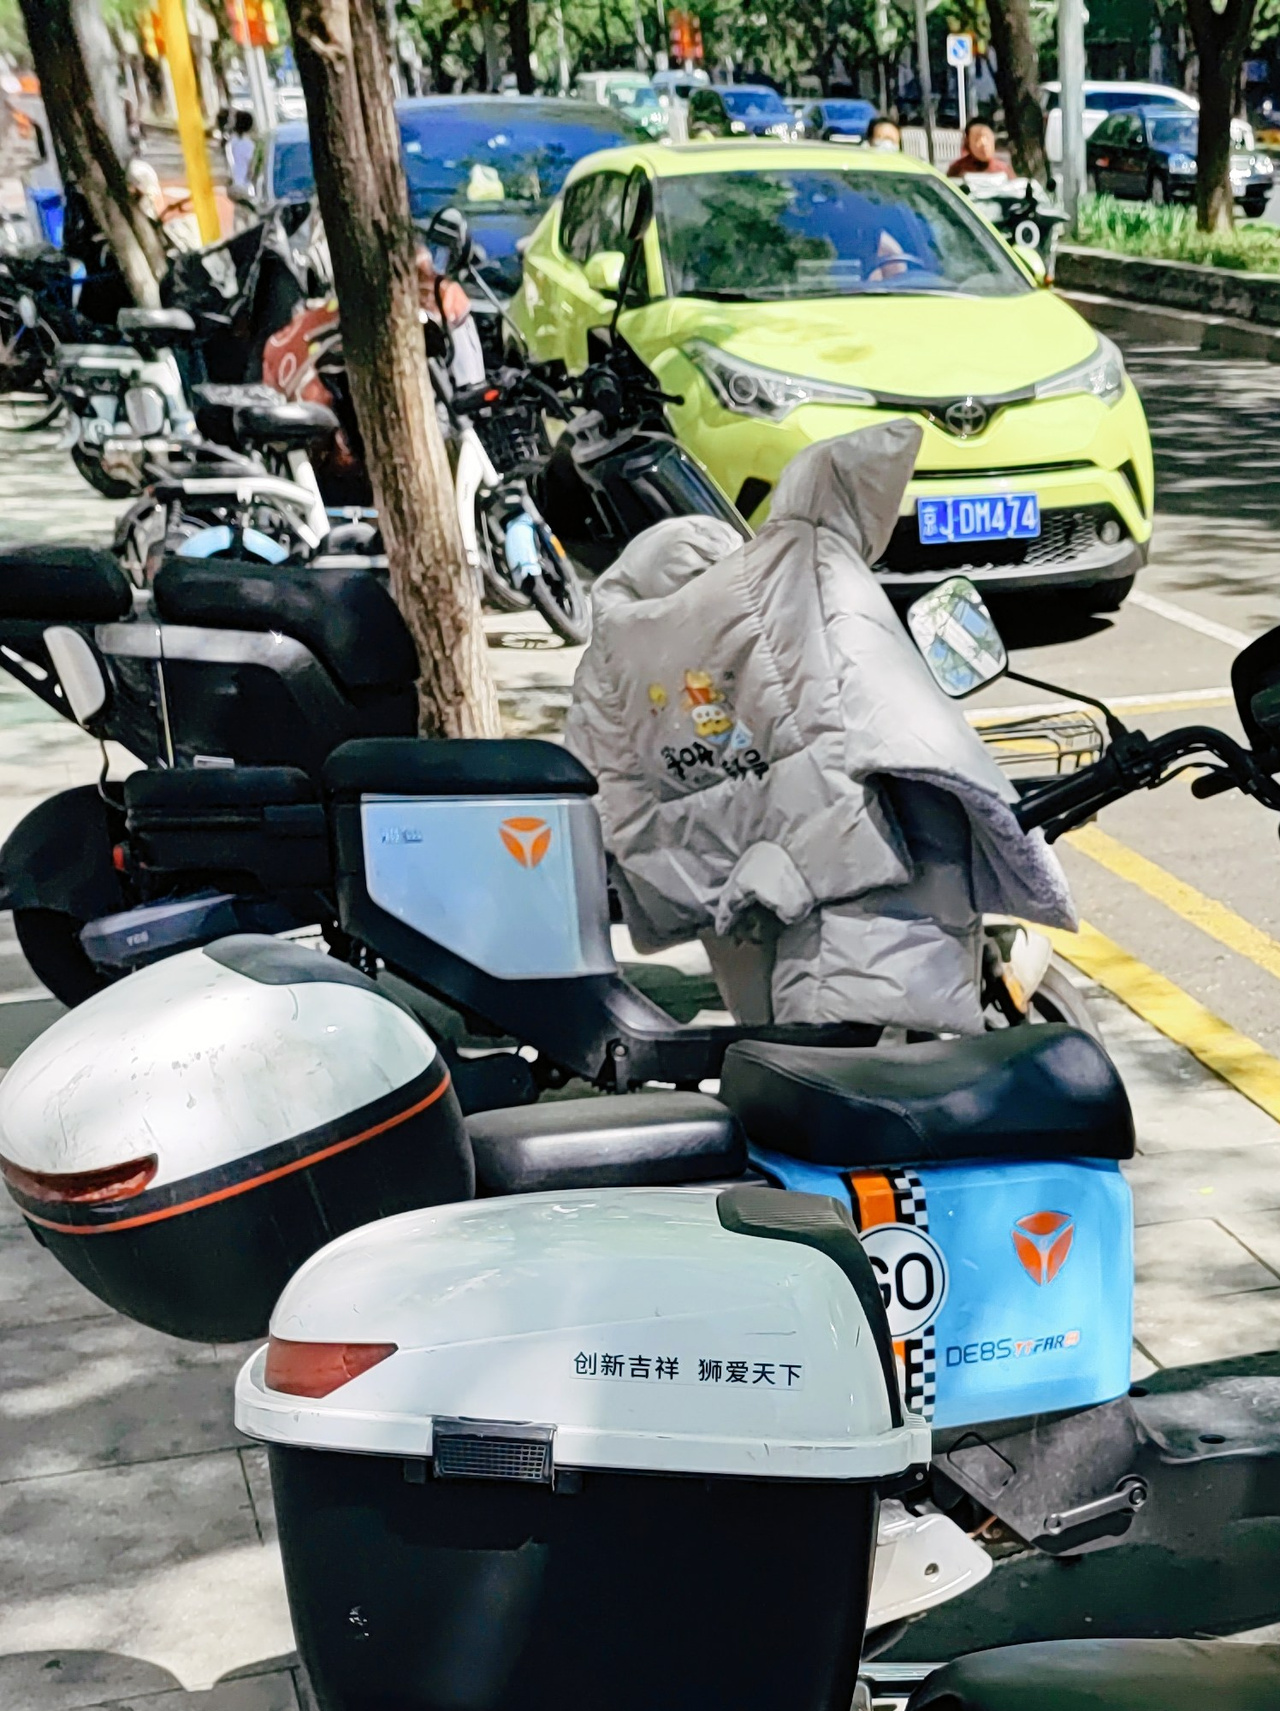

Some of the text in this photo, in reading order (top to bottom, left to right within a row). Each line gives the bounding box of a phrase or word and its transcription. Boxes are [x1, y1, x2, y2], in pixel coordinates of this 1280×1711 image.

[573, 1351, 802, 1386] 创新吉祥 狮爱天下
